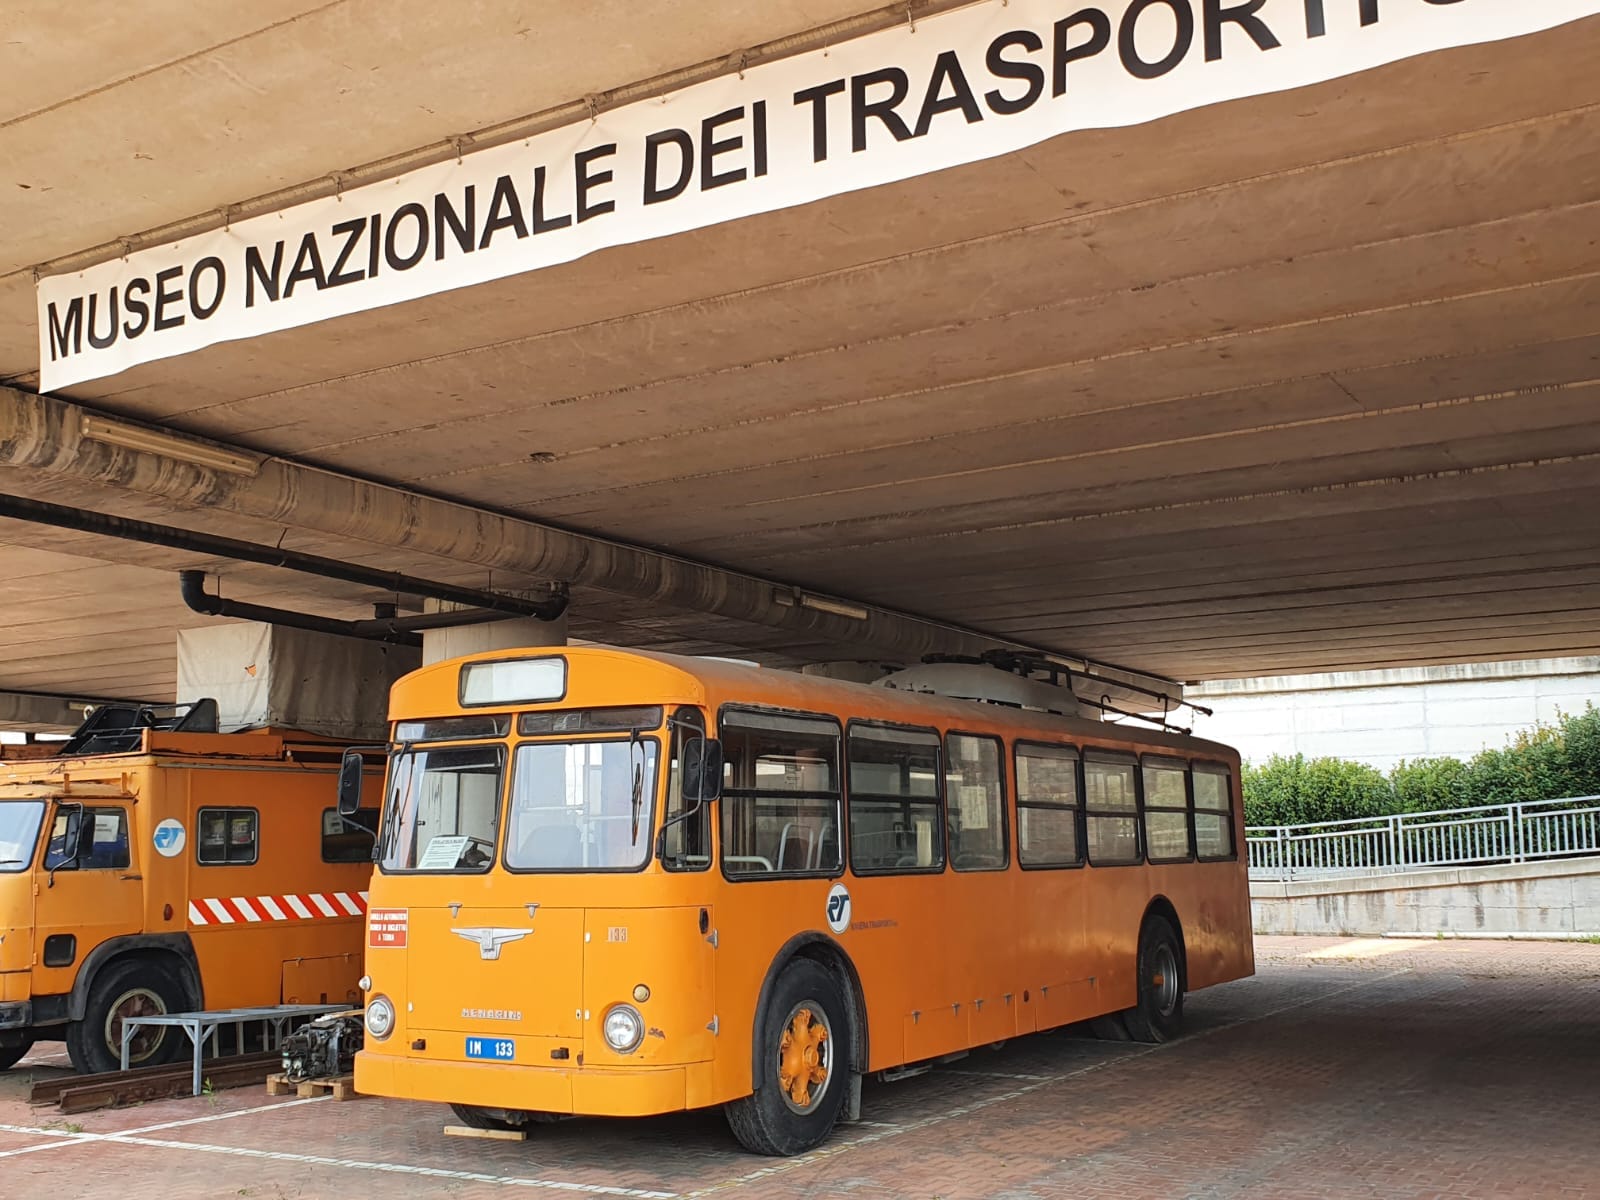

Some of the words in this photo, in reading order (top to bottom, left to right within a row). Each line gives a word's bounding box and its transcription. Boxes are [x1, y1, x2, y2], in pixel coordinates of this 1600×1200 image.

[47, 256, 226, 362] MUSEO
[245, 143, 617, 308] NAZIONALE
[643, 100, 768, 206] DEI
[495, 1042, 513, 1057] 133
